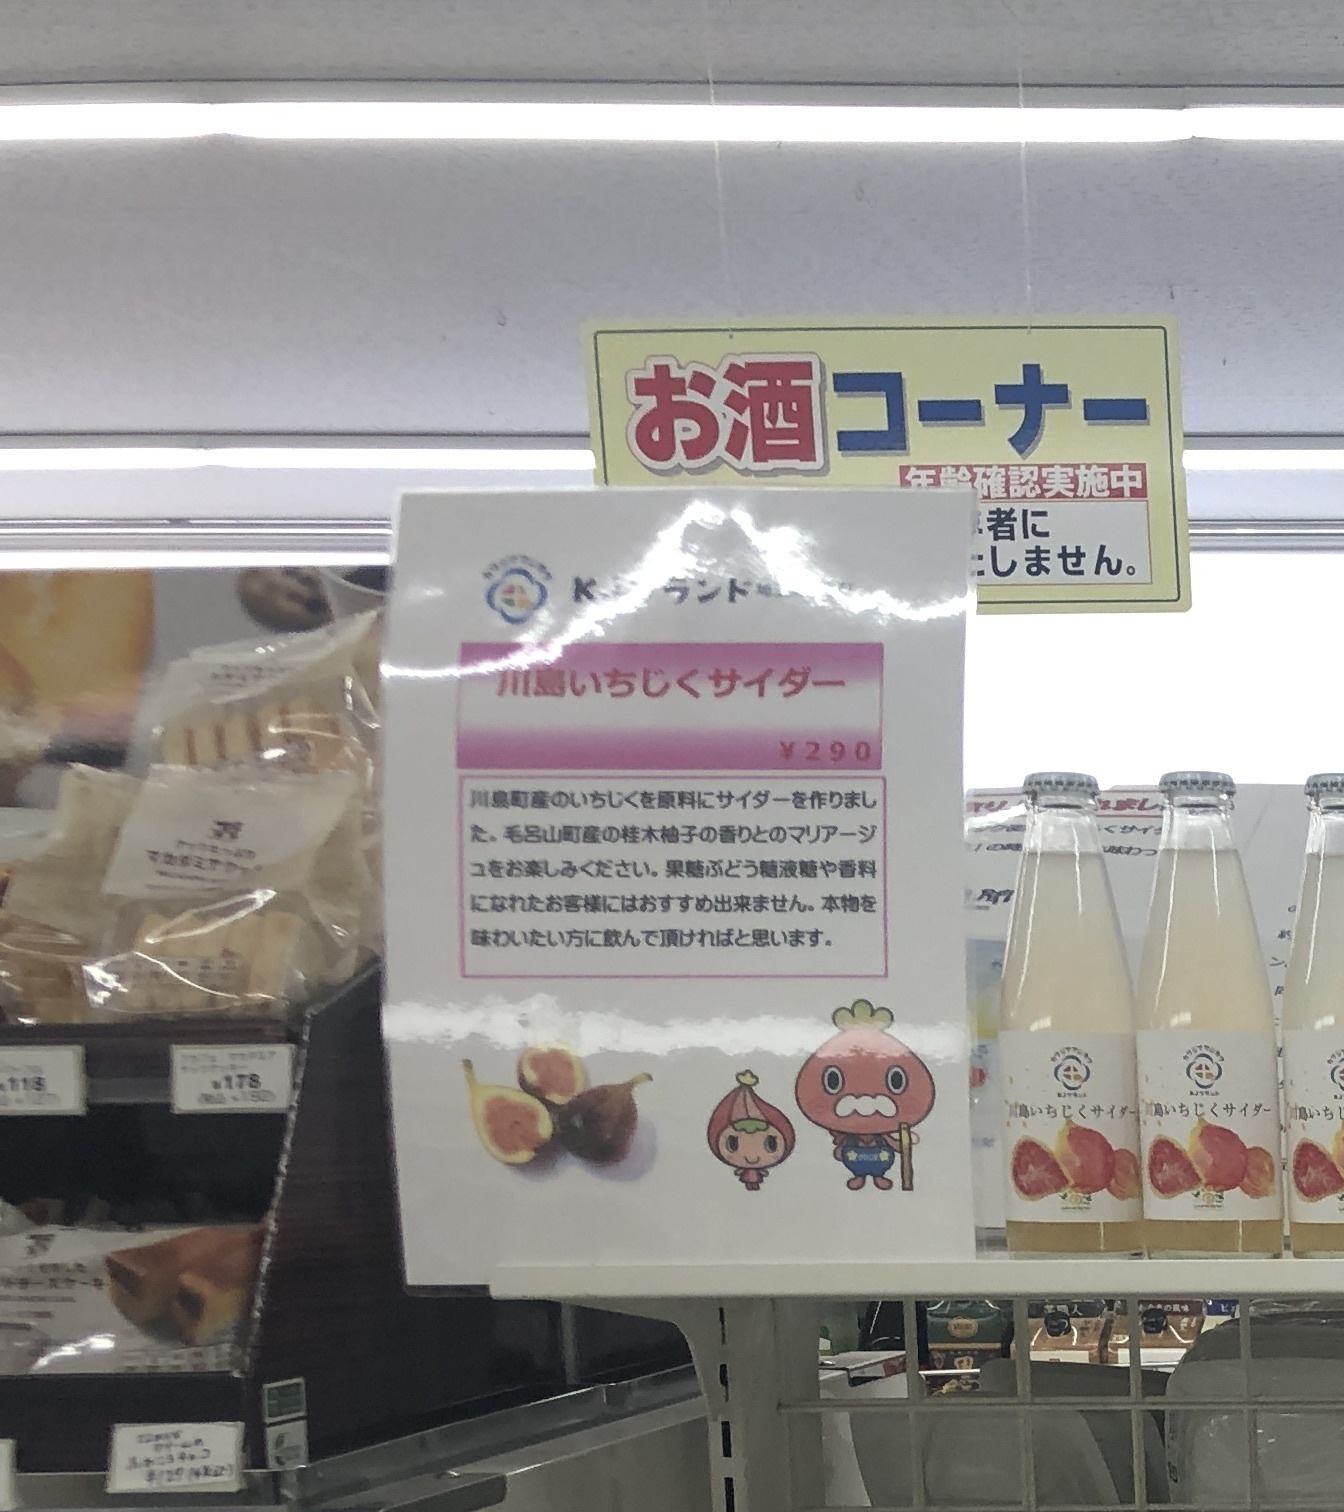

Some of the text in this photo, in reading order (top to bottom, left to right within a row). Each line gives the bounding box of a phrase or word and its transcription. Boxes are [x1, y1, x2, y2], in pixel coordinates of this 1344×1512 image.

[631, 355, 1148, 469] お酒コーナー
[905, 465, 1142, 498] 年齢確認実施中
[975, 508, 1049, 541] 者に
[971, 545, 1136, 577] しません。
[497, 666, 846, 699] 川島いちじくサイダー
[779, 741, 872, 764] ¥290
[469, 790, 878, 810] 川島町産のいちじくを原料にサイダーを作りまし
[469, 824, 877, 845] た。毛呂山町産の桂木柚子の香りとのマリアージ
[470, 859, 877, 880] ュをお楽しみください。果糖ぶどう糖液糖や香料
[470, 893, 878, 915] になれたお客様にはおすすめ出来ません。本物を
[470, 927, 833, 949] 味わいたい方に飲んで頂ければと思います。
[1008, 1102, 1137, 1120] 川島いちじくサイダー
[1145, 1101, 1272, 1119] 川島いちじくサイダー
